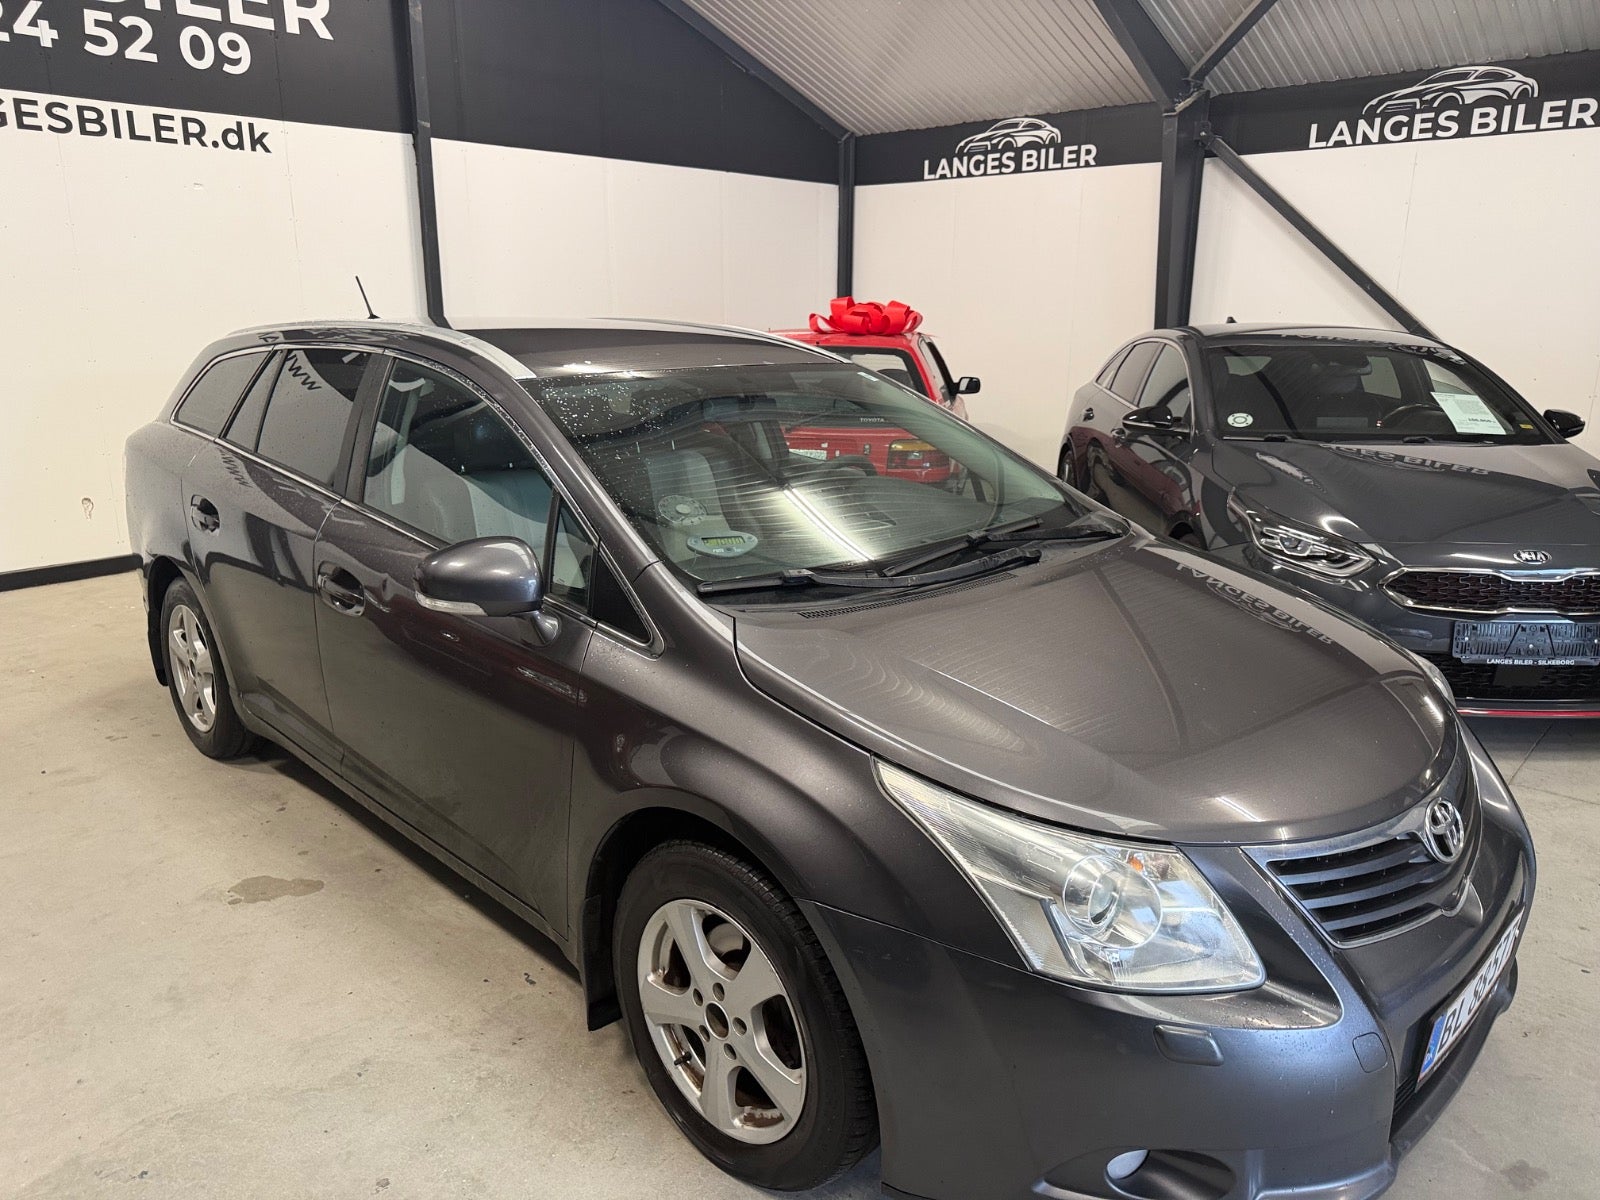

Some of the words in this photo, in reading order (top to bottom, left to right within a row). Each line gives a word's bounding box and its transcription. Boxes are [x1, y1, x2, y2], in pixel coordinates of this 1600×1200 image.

[0, 0, 59, 48] 4
[83, 8, 158, 63] 52
[179, 25, 251, 75] 09
[1308, 110, 1460, 149] LANGES
[1470, 97, 1599, 135] BILER
[923, 152, 1015, 180] LANGES
[1021, 144, 1097, 171] BILER
[1437, 996, 1466, 1054] BL
